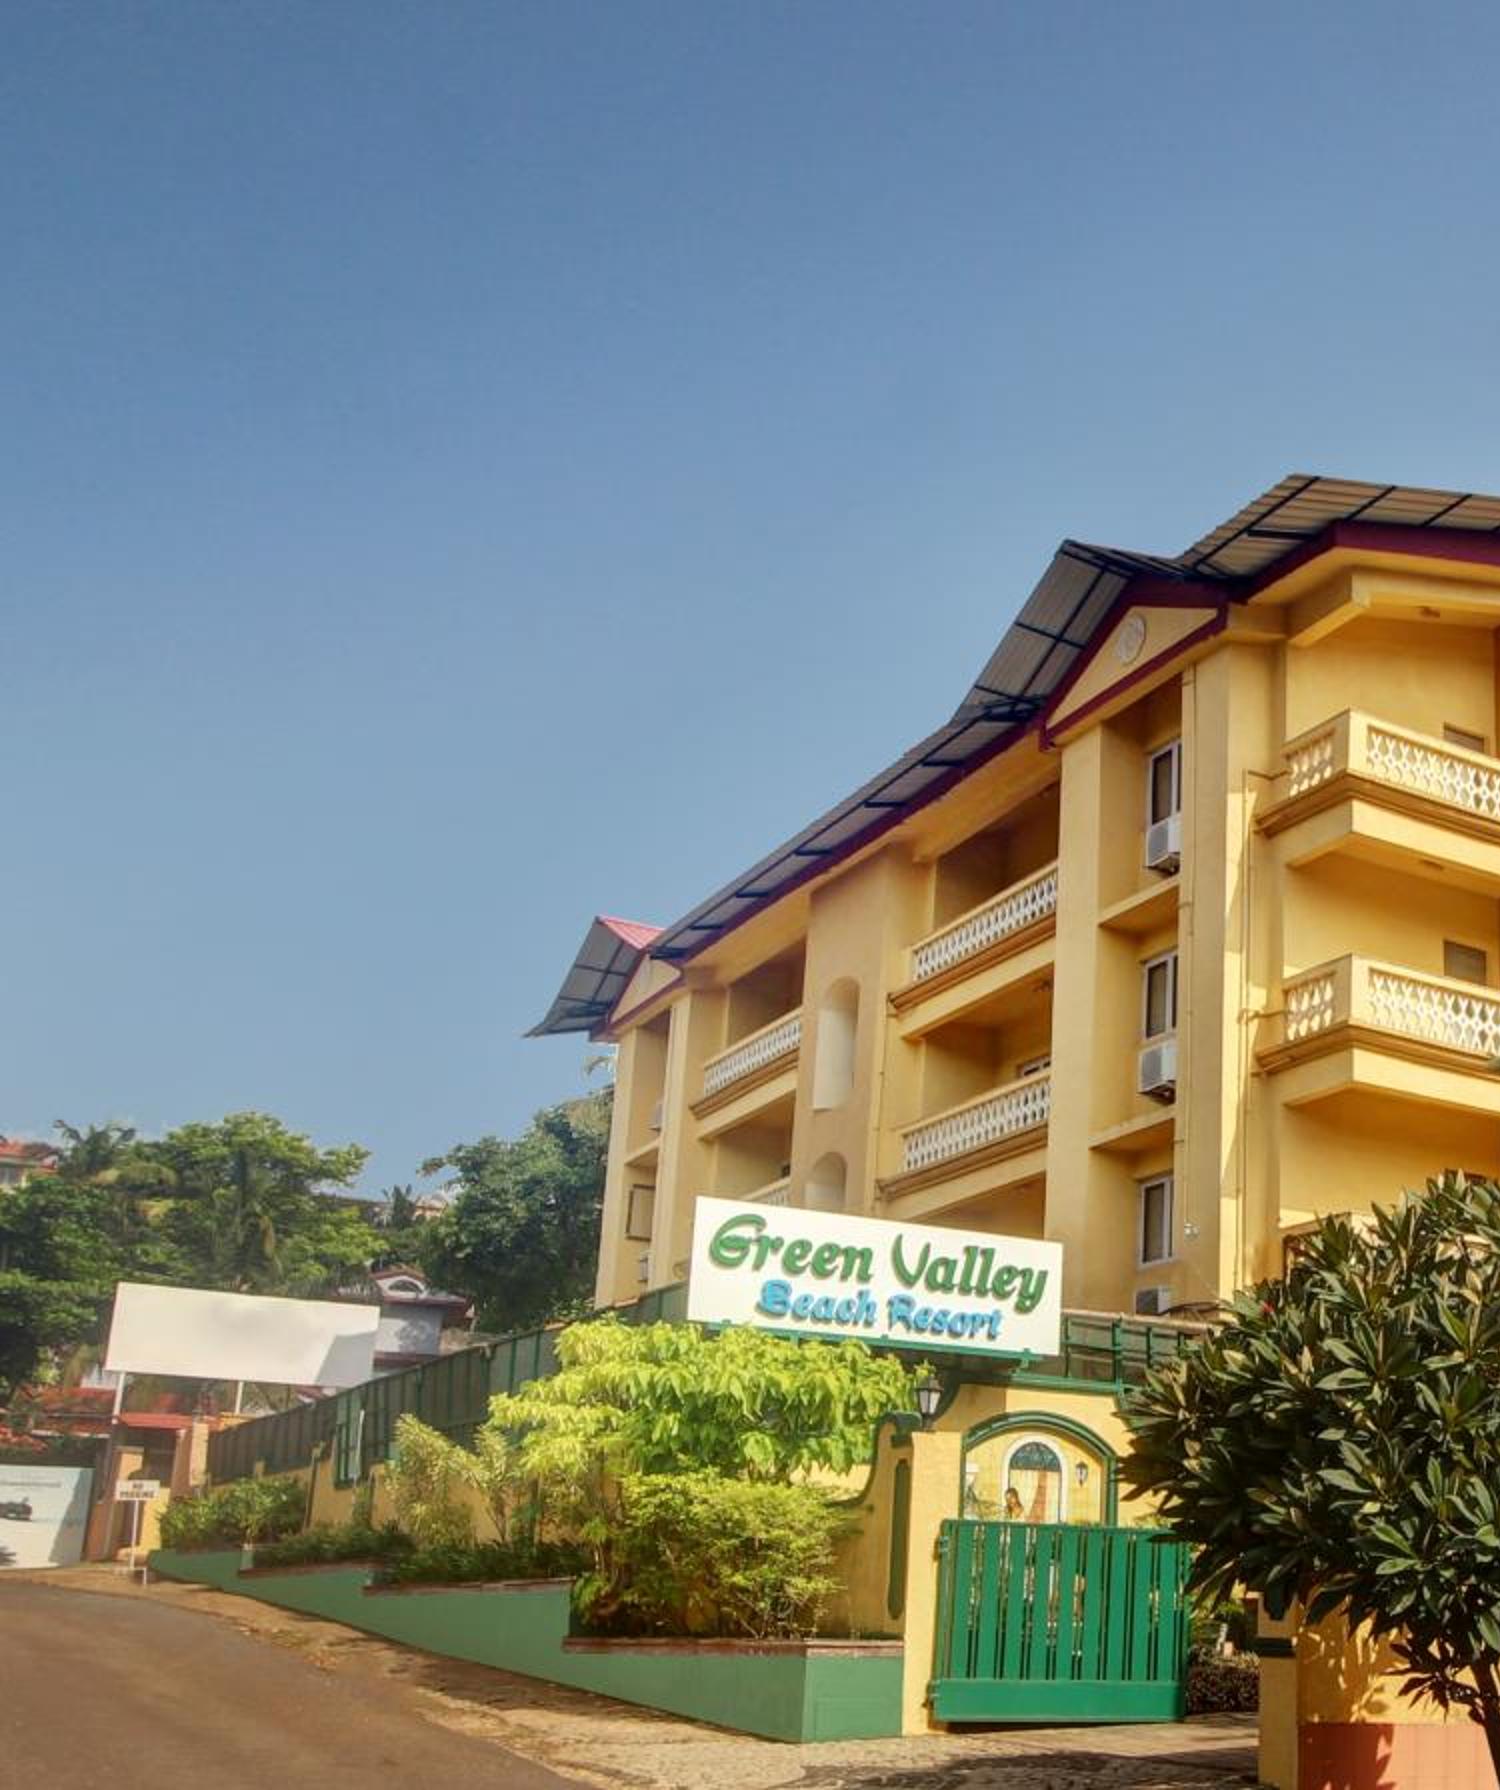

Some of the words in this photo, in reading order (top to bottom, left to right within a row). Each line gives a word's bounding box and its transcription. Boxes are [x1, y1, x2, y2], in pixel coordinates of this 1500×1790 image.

[709, 1213, 873, 1283] Green
[891, 1233, 1048, 1314] Valley
[757, 1279, 876, 1327] Beach
[887, 1293, 1002, 1340] Resort
